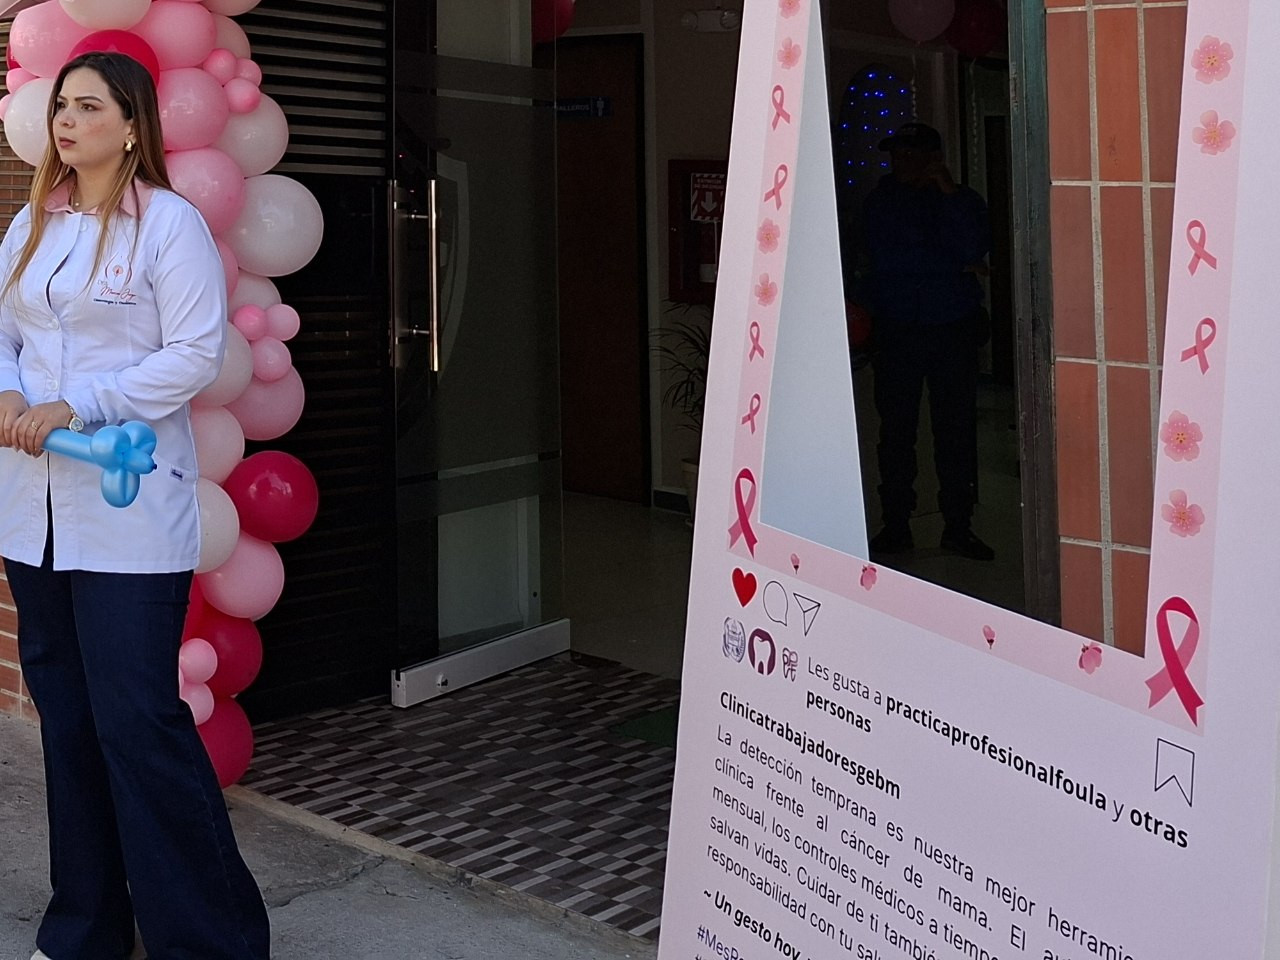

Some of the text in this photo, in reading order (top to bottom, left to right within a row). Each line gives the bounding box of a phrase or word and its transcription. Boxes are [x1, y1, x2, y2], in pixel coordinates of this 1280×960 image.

[721, 691, 900, 799] Clinicatrabajadoresgebm
[807, 691, 872, 732] personas
[808, 657, 829, 681] Les
[833, 672, 869, 700] gusta
[874, 691, 882, 705] a
[886, 696, 1107, 810] practicaprofesionalfoula
[1112, 800, 1124, 822] y
[1130, 809, 1188, 848] otras
[710, 816, 749, 850] salvan
[755, 841, 791, 877] vidas.
[797, 866, 841, 907] Cuidar
[846, 900, 864, 922] de
[870, 913, 879, 933] ti
[712, 786, 767, 832] mensual,
[772, 817, 790, 843] los
[795, 835, 857, 884] controles
[861, 876, 924, 925] médicos
[929, 918, 937, 935] a
[715, 757, 1026, 951] clínica frente al cáncer de mama. El
[718, 724, 732, 746] La
[740, 739, 802, 784] detección
[812, 776, 876, 826] temprana
[887, 822, 904, 841] es
[914, 836, 973, 882] nuestra
[986, 877, 1035, 916] mejor
[707, 844, 806, 920] responsabilidad
[810, 912, 835, 940] con
[840, 928, 853, 951] tu
[714, 890, 732, 916] Un
[734, 909, 772, 943] gesto
